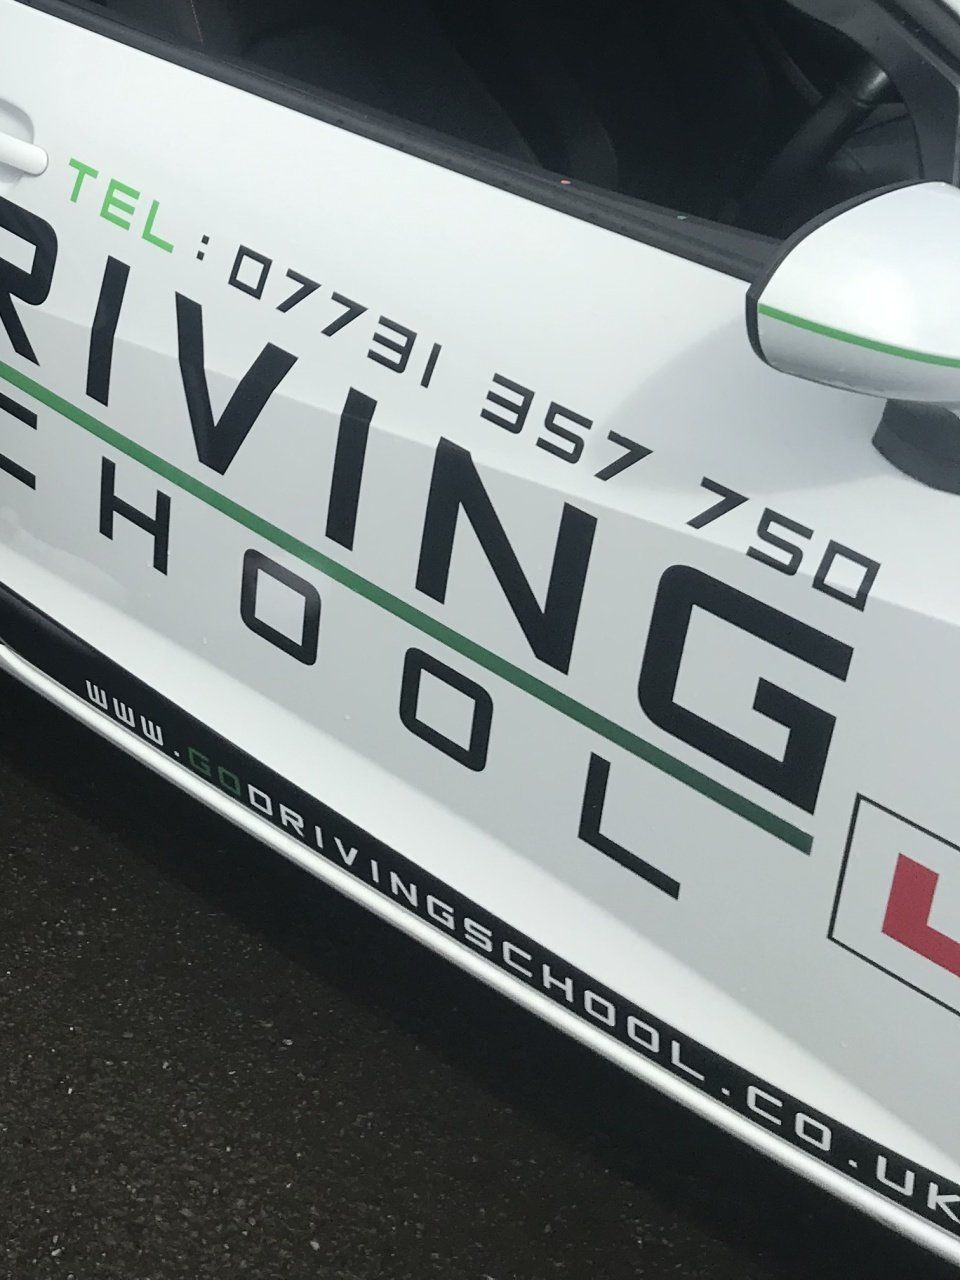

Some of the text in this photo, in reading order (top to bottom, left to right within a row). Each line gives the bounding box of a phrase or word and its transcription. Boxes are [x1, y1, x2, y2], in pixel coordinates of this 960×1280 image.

[228, 245, 442, 388] 07731
[480, 373, 653, 480] 357
[686, 476, 881, 611] 750
[881, 852, 960, 979] L
